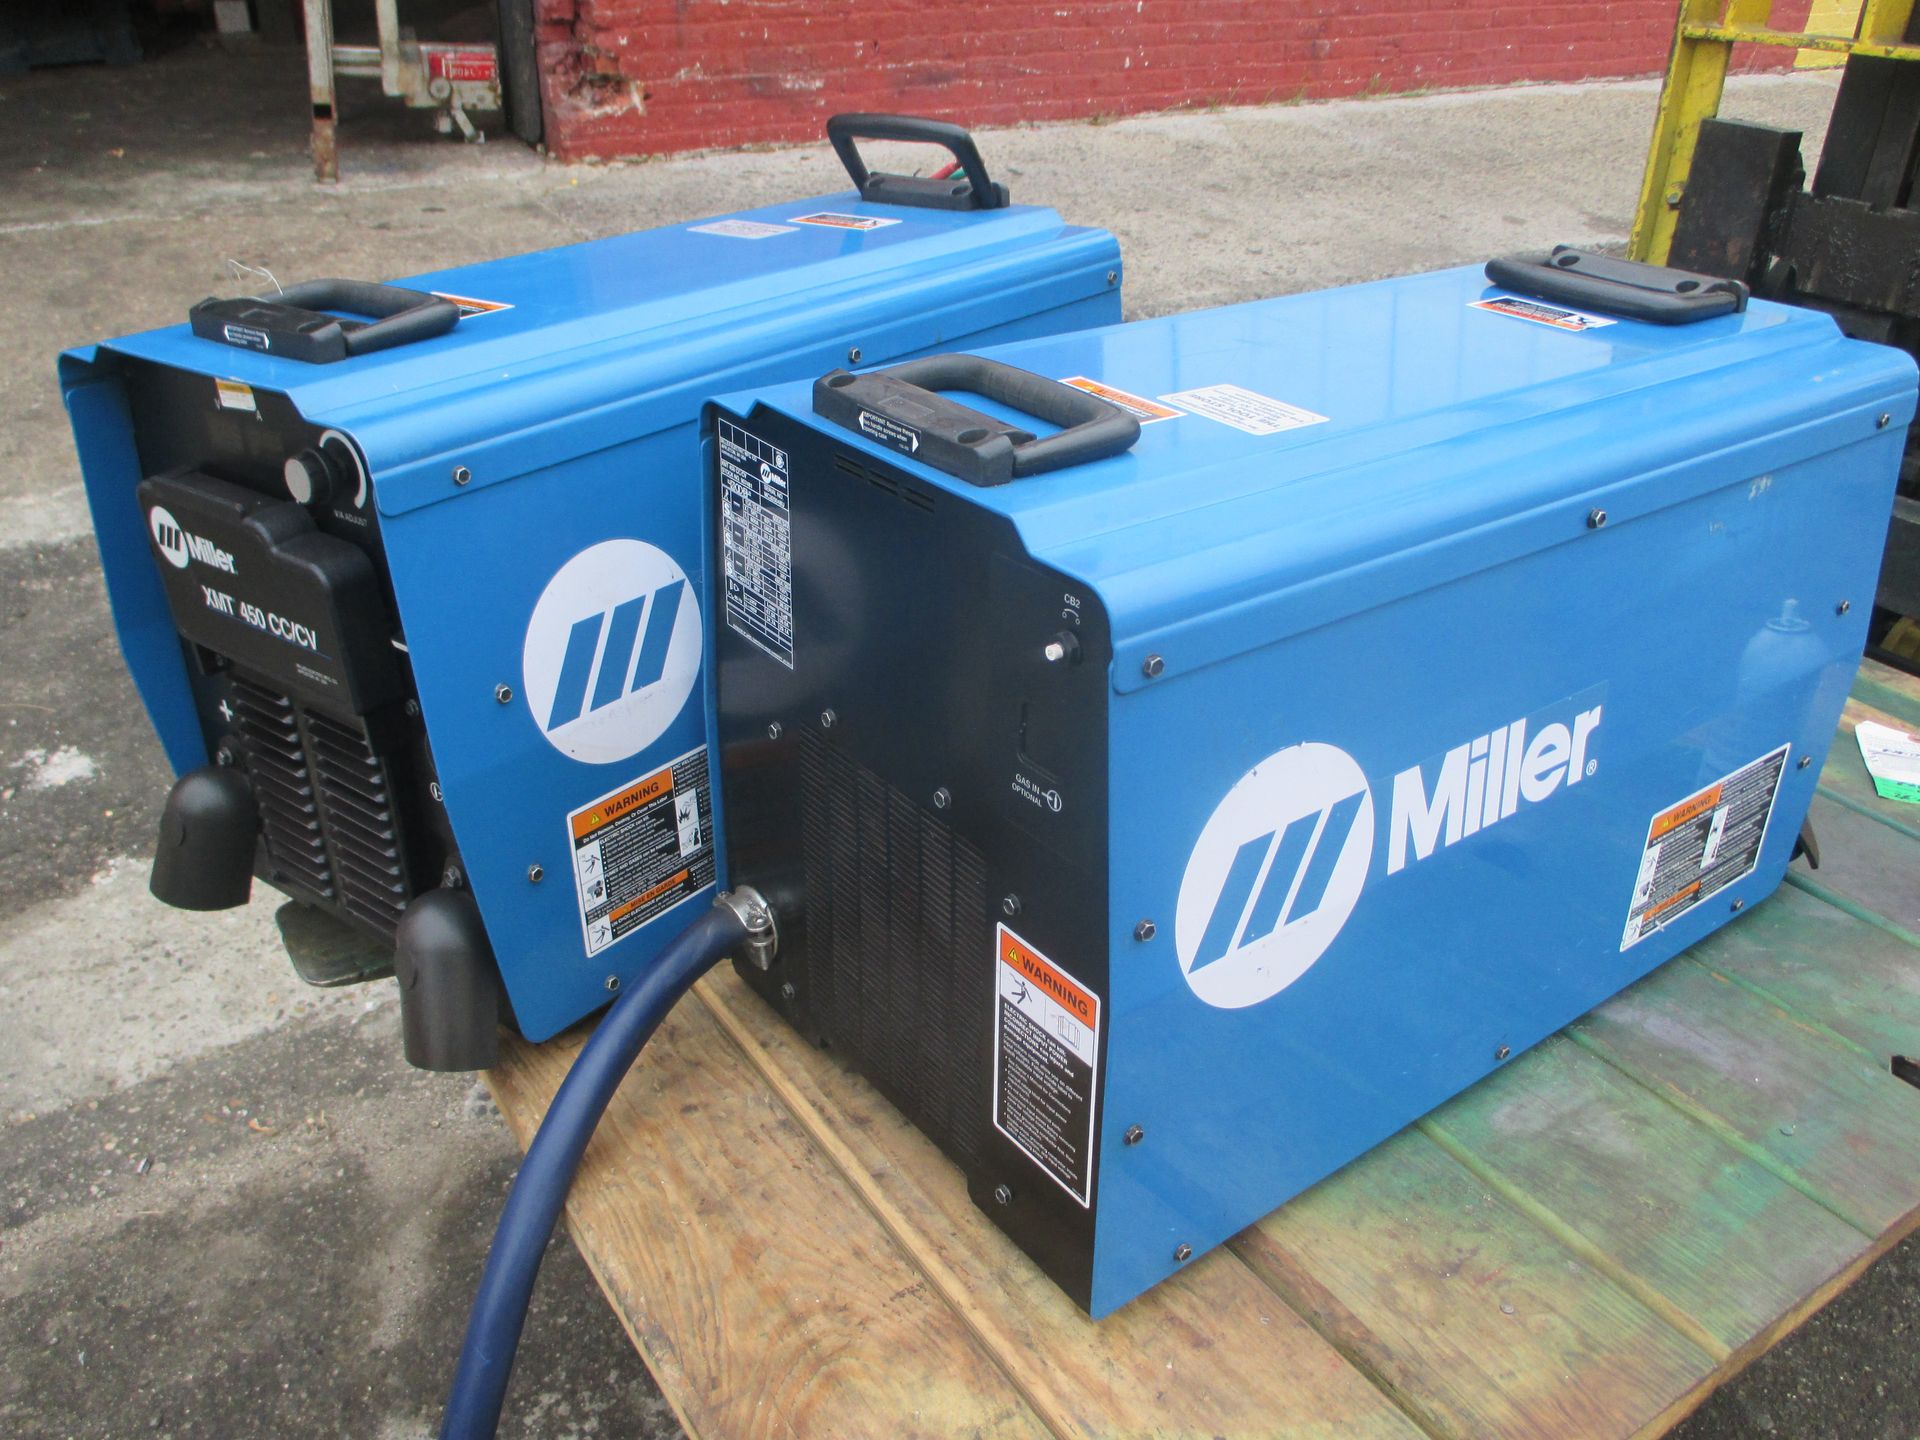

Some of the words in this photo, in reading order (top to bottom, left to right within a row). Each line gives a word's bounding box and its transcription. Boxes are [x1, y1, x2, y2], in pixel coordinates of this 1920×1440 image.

[771, 472, 786, 488] Miller
[184, 531, 236, 574] Miller
[202, 585, 235, 616] XMT
[240, 601, 267, 630] 450
[268, 612, 317, 650] CC/CV
[1064, 593, 1081, 609] CB2
[604, 782, 660, 817] WARNING
[1012, 782, 1042, 808] OPTIONAL
[1015, 773, 1031, 789] GAS
[1032, 781, 1040, 794] IN
[630, 895, 644, 908] MISE
[646, 889, 654, 899] EN
[655, 877, 675, 893] GARDE
[1022, 955, 1088, 1017] WARNING
[1004, 1001, 1027, 1026] ELECTRIC
[1028, 1021, 1045, 1041] SHOCK
[1046, 1036, 1055, 1050] can
[1004, 1015, 1038, 1049] CONNECTIONS
[1039, 1045, 1048, 1058] can
[1004, 1008, 1031, 1036] INCORRECT
[1032, 1032, 1047, 1050] INPUT
[1048, 1045, 1067, 1066] POWER
